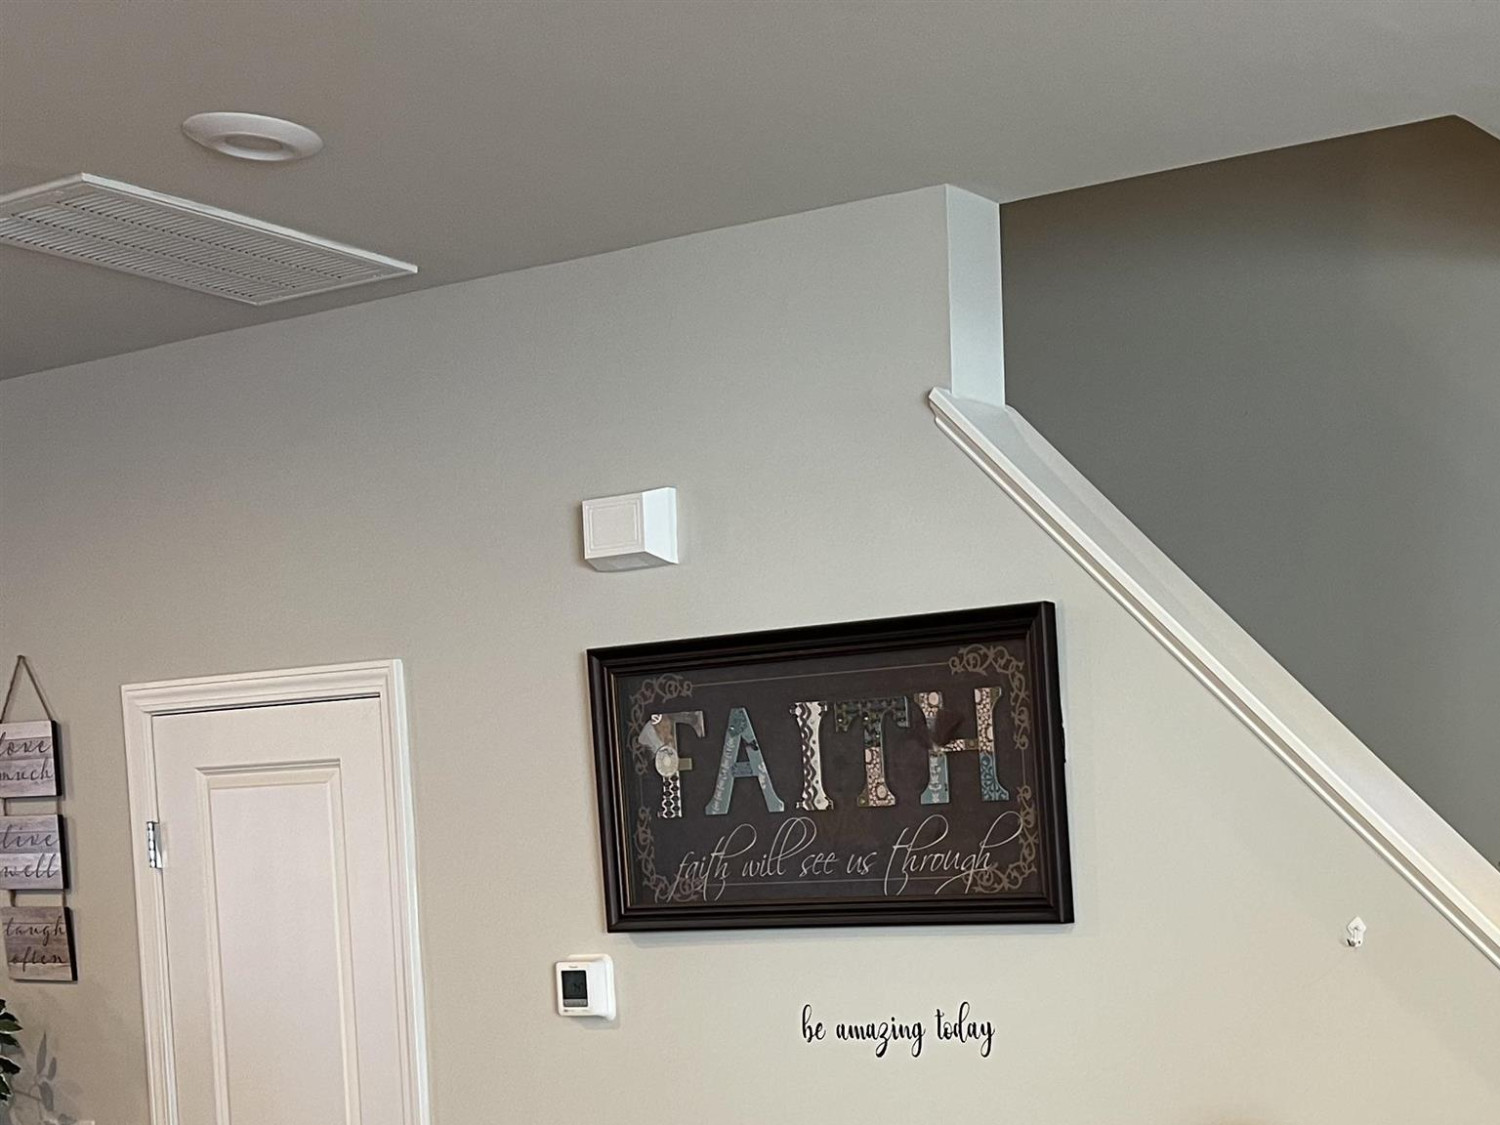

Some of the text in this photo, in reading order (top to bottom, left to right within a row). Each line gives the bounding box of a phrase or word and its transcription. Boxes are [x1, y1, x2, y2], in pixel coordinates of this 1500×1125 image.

[650, 686, 1010, 820] FAITH
[2, 824, 58, 849] live
[0, 853, 59, 878] well
[667, 811, 1023, 902] faith will see us through
[6, 915, 66, 947] laugh
[9, 946, 66, 972] often
[801, 1001, 996, 1058] be amazing today
